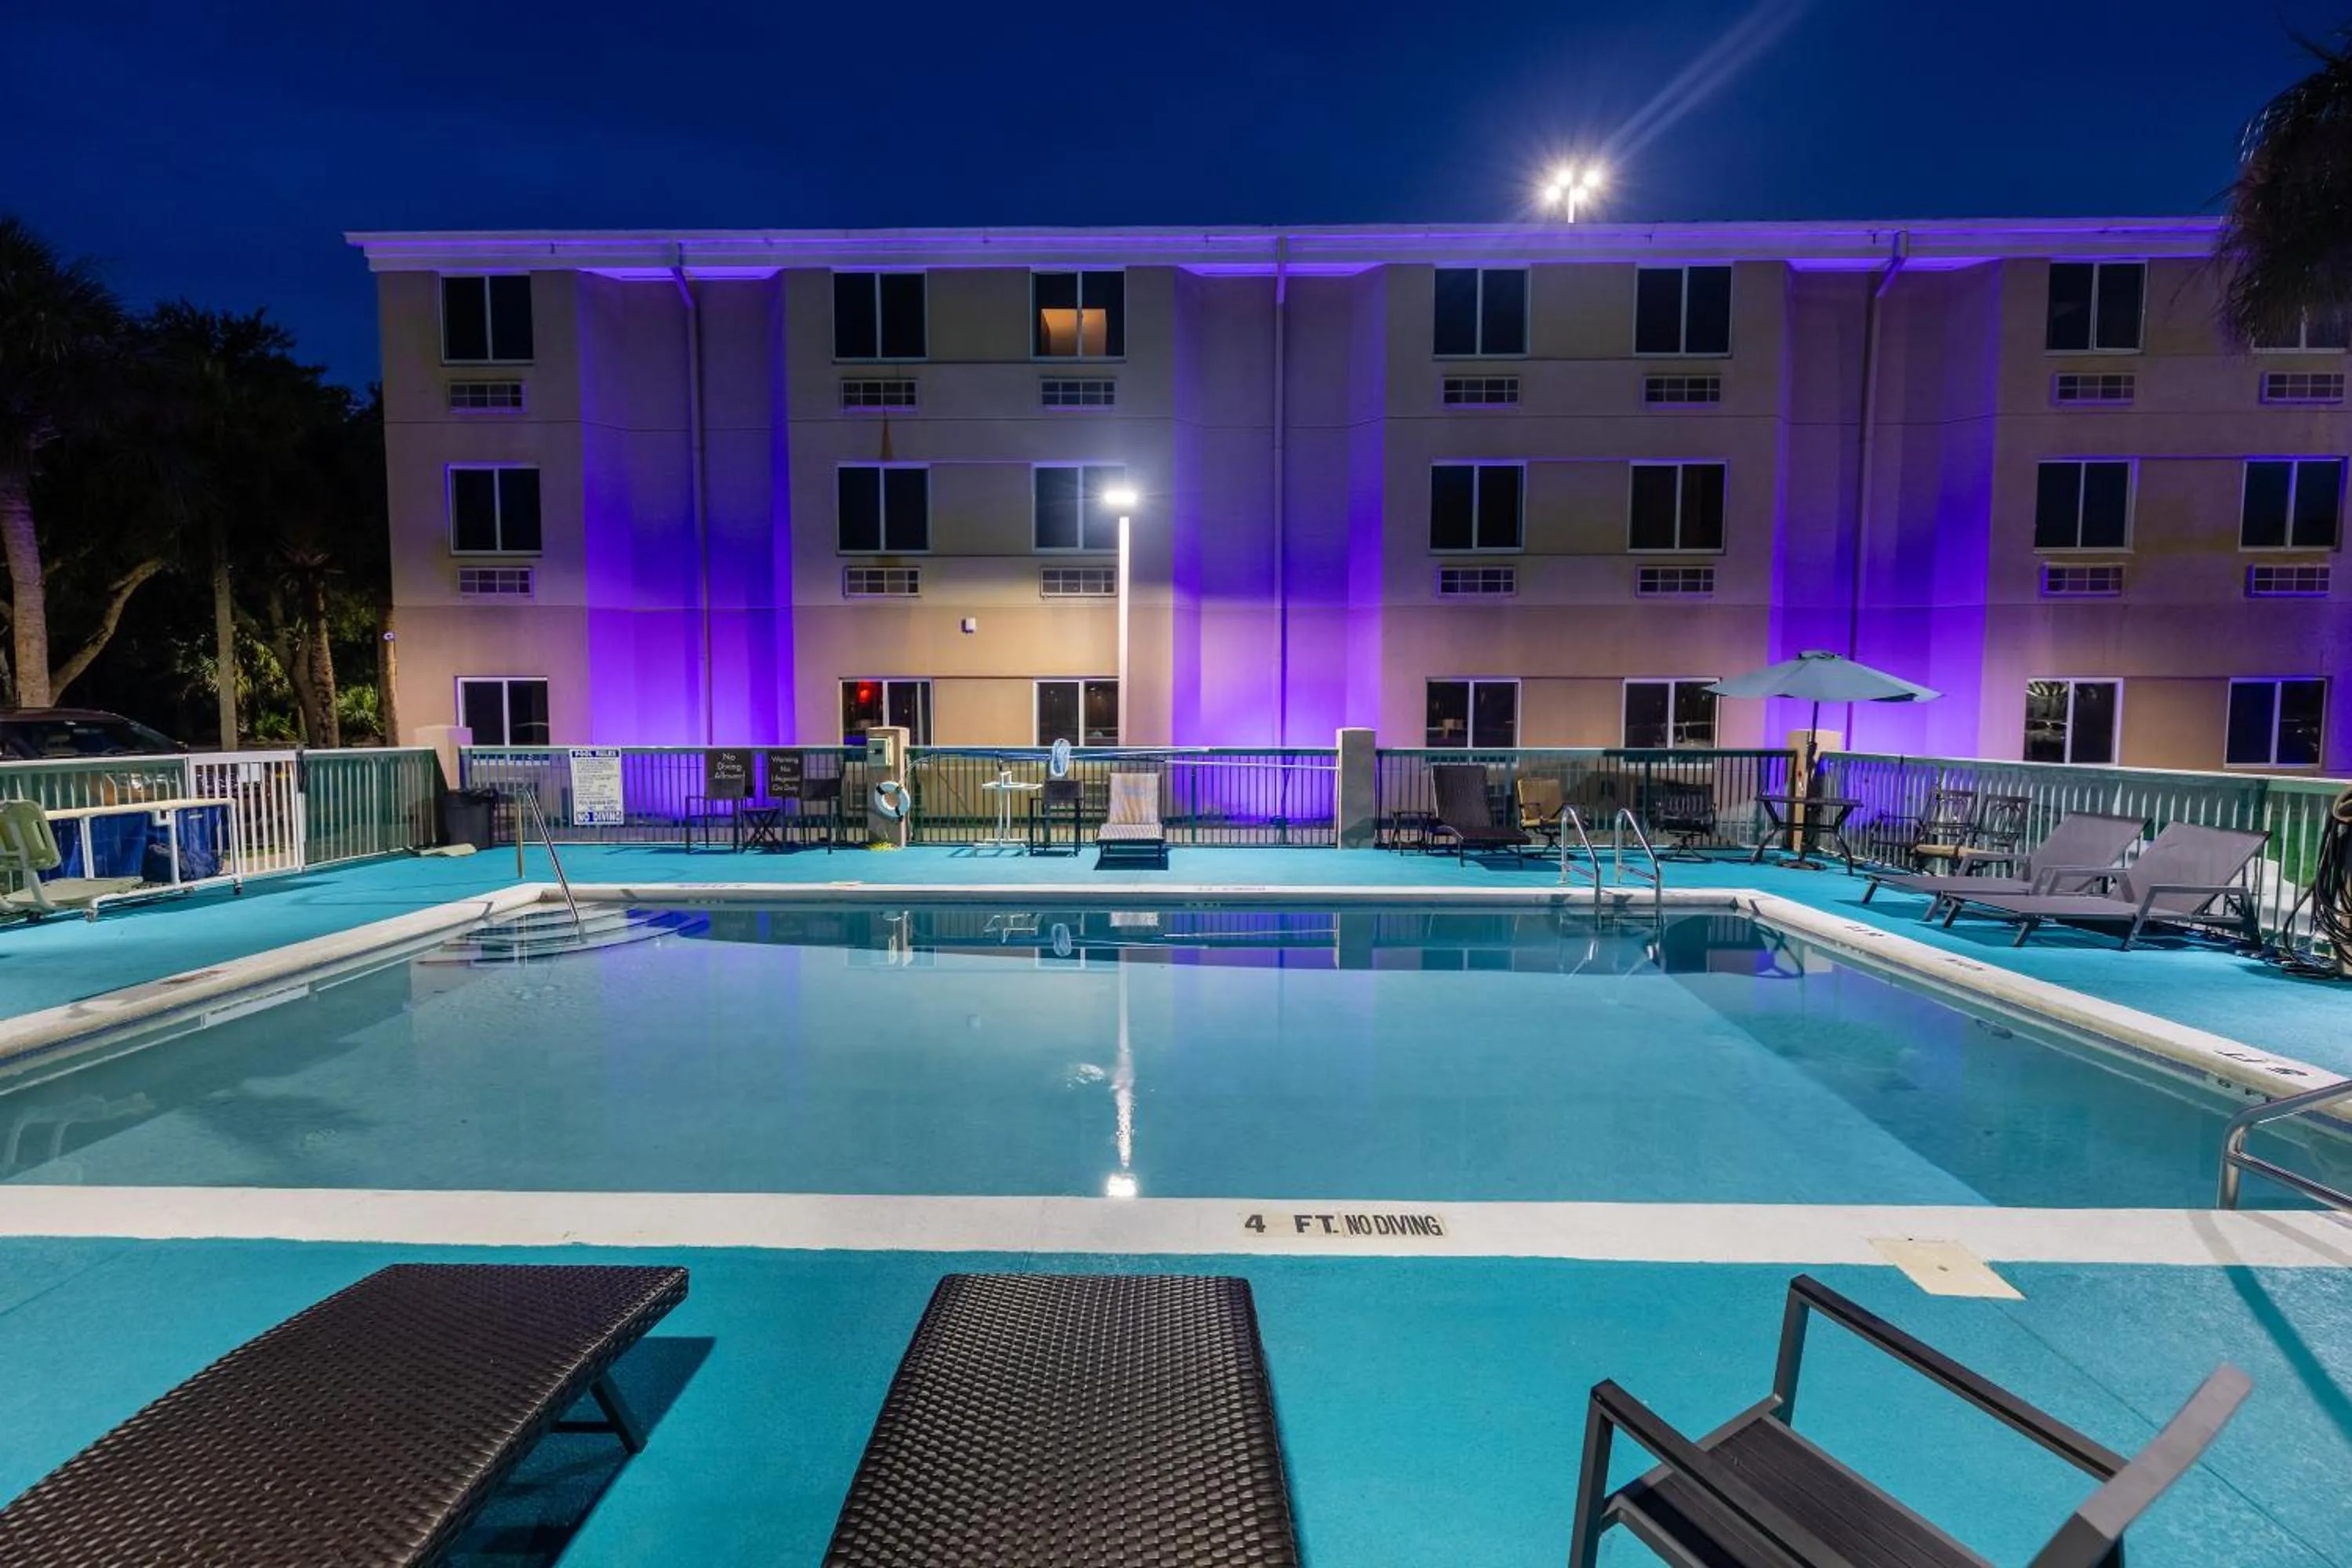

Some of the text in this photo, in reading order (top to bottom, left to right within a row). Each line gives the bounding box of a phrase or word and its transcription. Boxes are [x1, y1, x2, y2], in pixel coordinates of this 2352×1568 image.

[723, 752, 736, 760] No
[1244, 1214, 1265, 1233] 4
[1345, 1215, 1372, 1235] NO
[1374, 1215, 1443, 1236] DIVING
